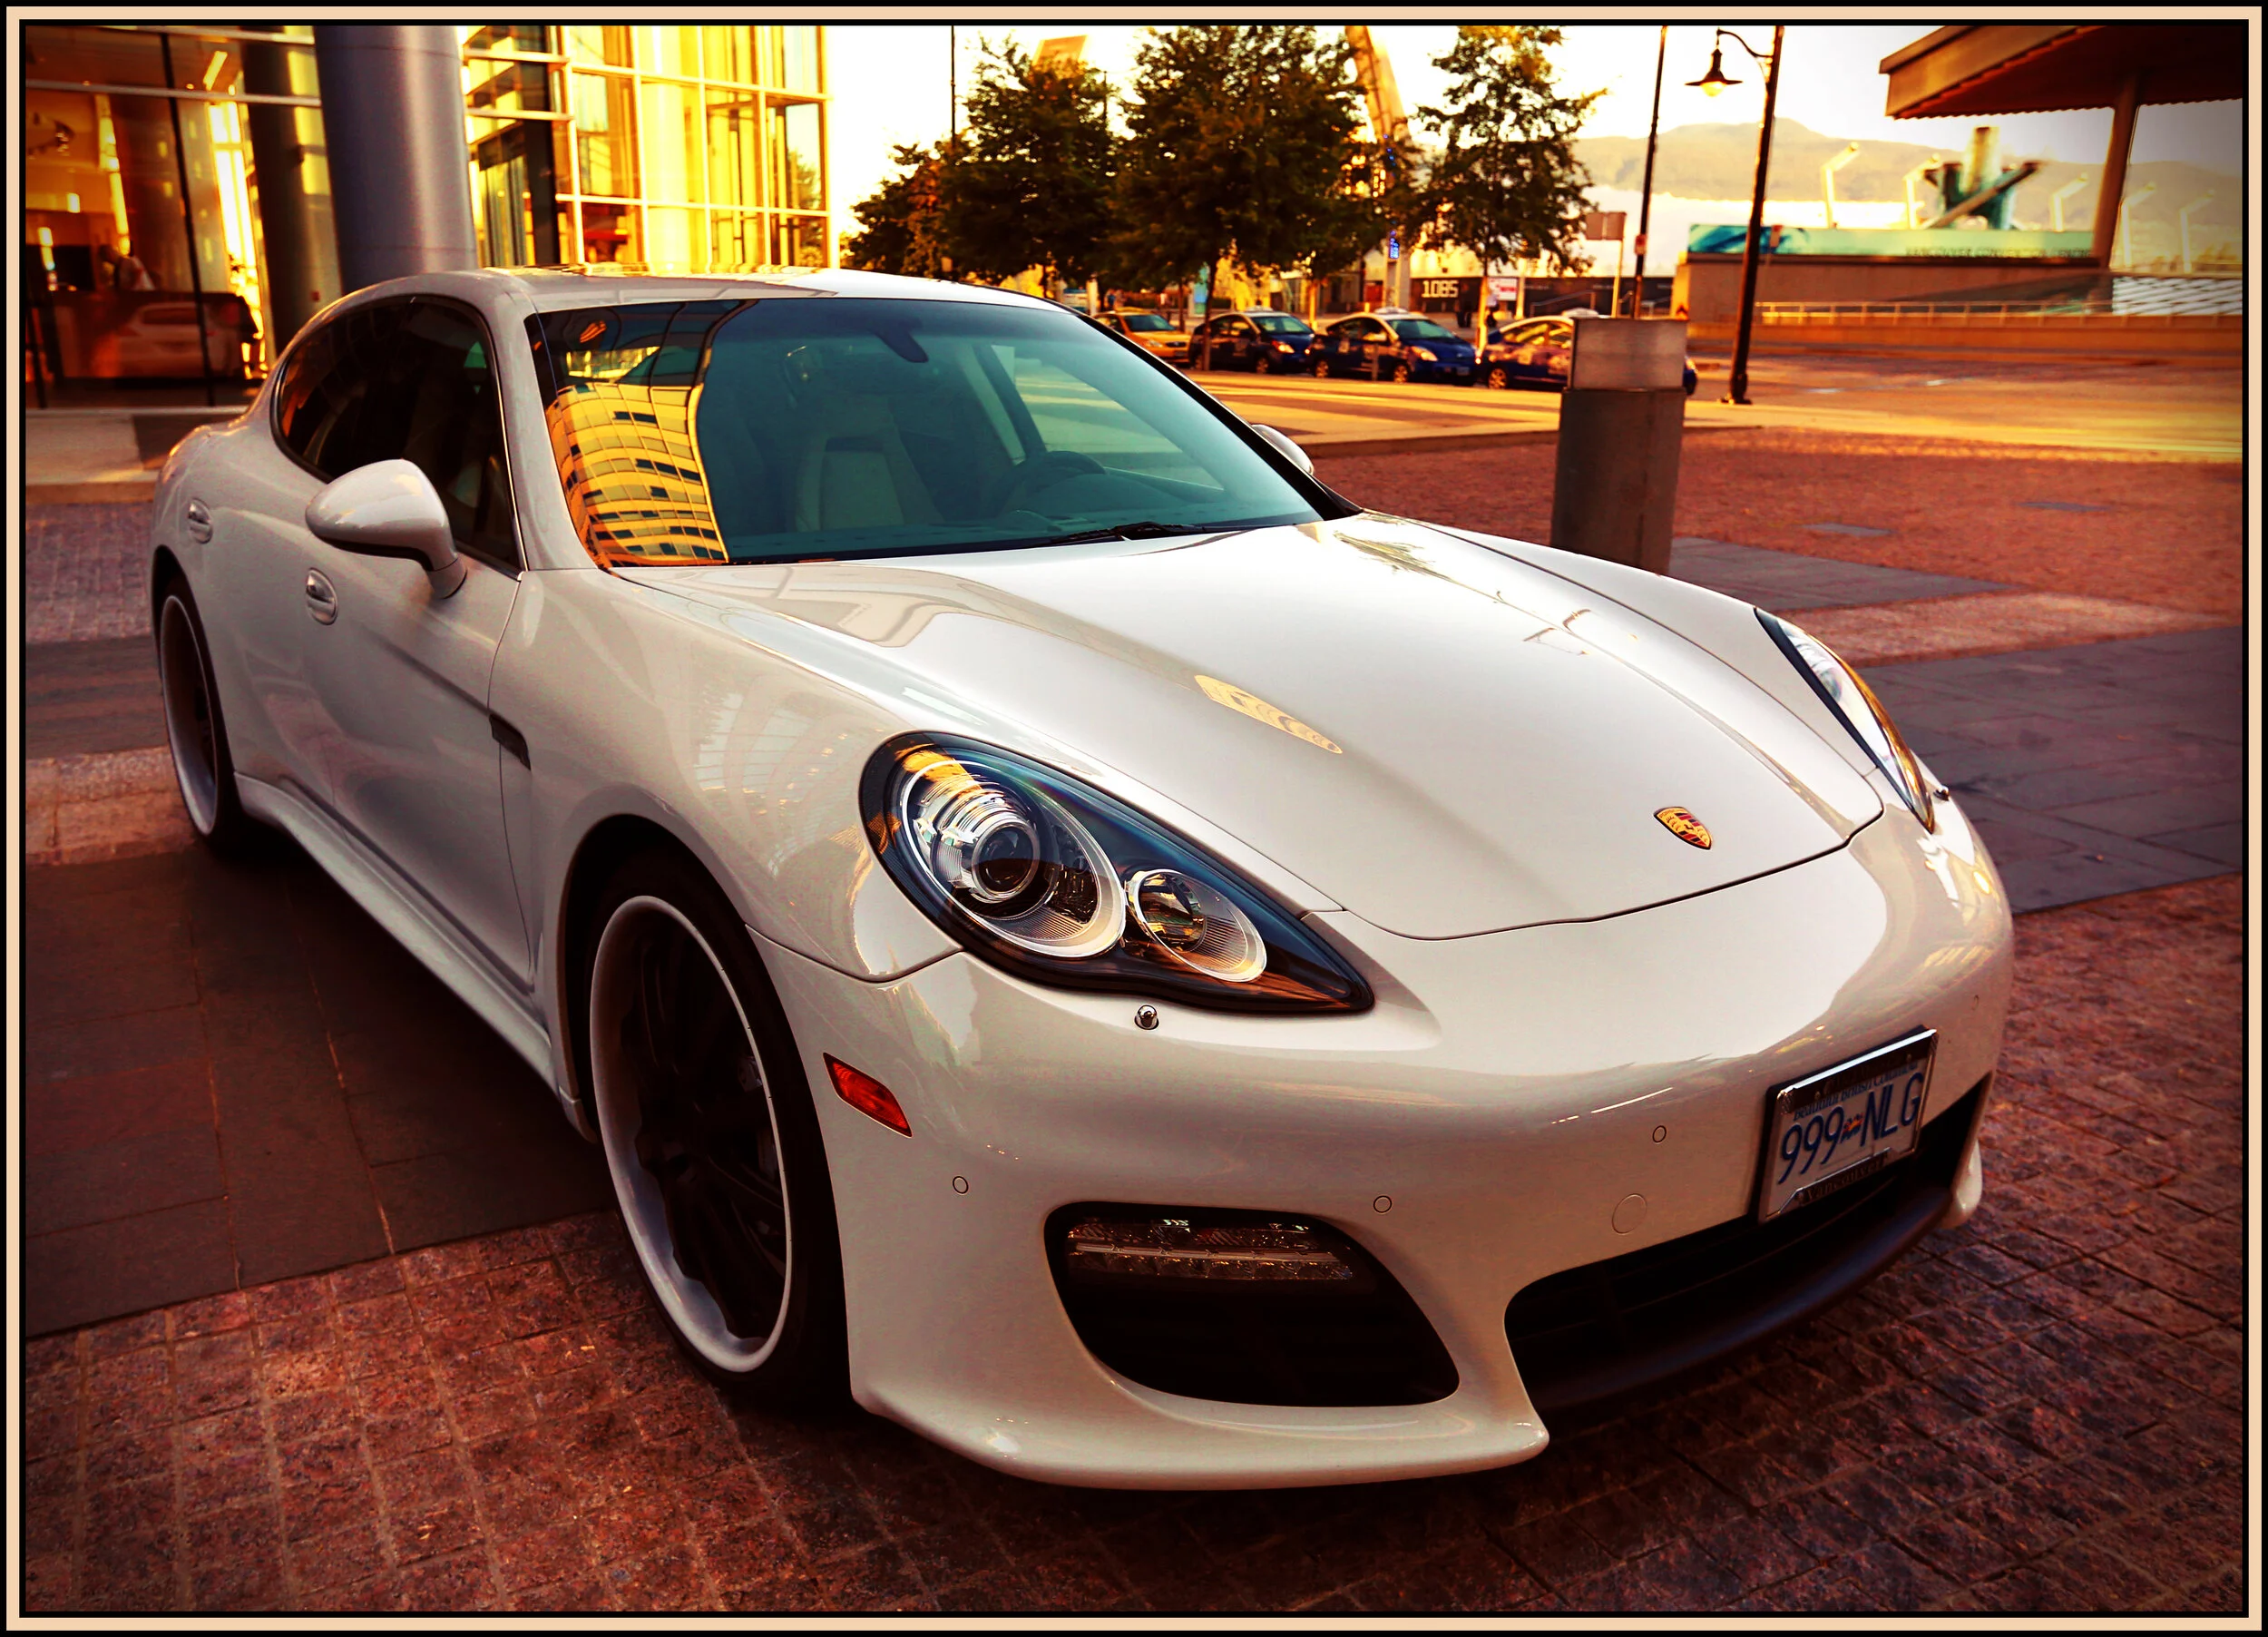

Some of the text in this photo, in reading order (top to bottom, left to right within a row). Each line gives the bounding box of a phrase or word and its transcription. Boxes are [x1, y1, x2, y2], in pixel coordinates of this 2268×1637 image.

[1422, 279, 1459, 298] 1085
[1778, 1106, 1844, 1184] 999
[1861, 1072, 1923, 1147] NLG
